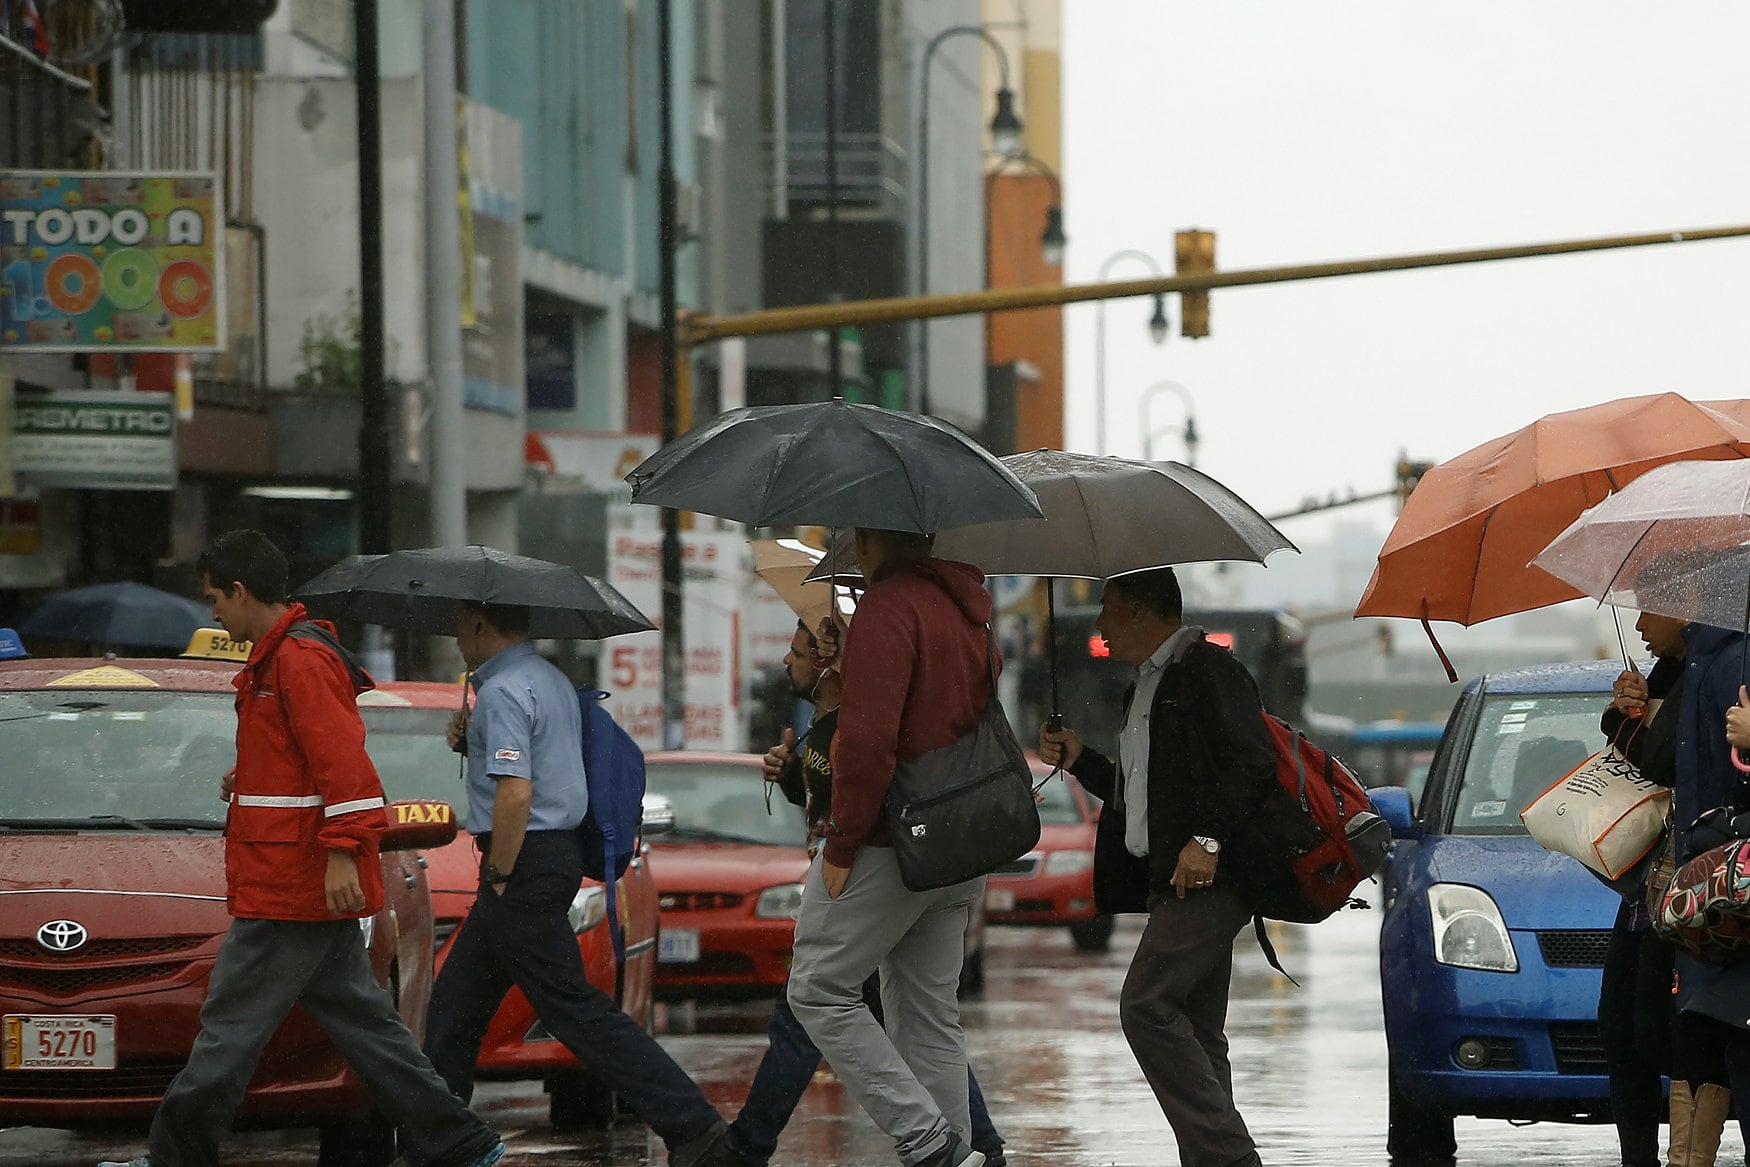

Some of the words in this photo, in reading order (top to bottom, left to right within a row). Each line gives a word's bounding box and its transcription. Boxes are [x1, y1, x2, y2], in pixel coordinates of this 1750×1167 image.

[3, 208, 149, 246] TODO
[168, 208, 204, 246] A
[3, 249, 215, 322] 1.000
[211, 636, 247, 653] 5270
[612, 648, 637, 688] 5
[393, 804, 450, 823] TAXI
[34, 1020, 61, 1028] COSTA
[65, 1020, 85, 1028] RICA
[39, 1029, 97, 1057] 5270
[24, 1059, 96, 1067] CENTROAMERICA
